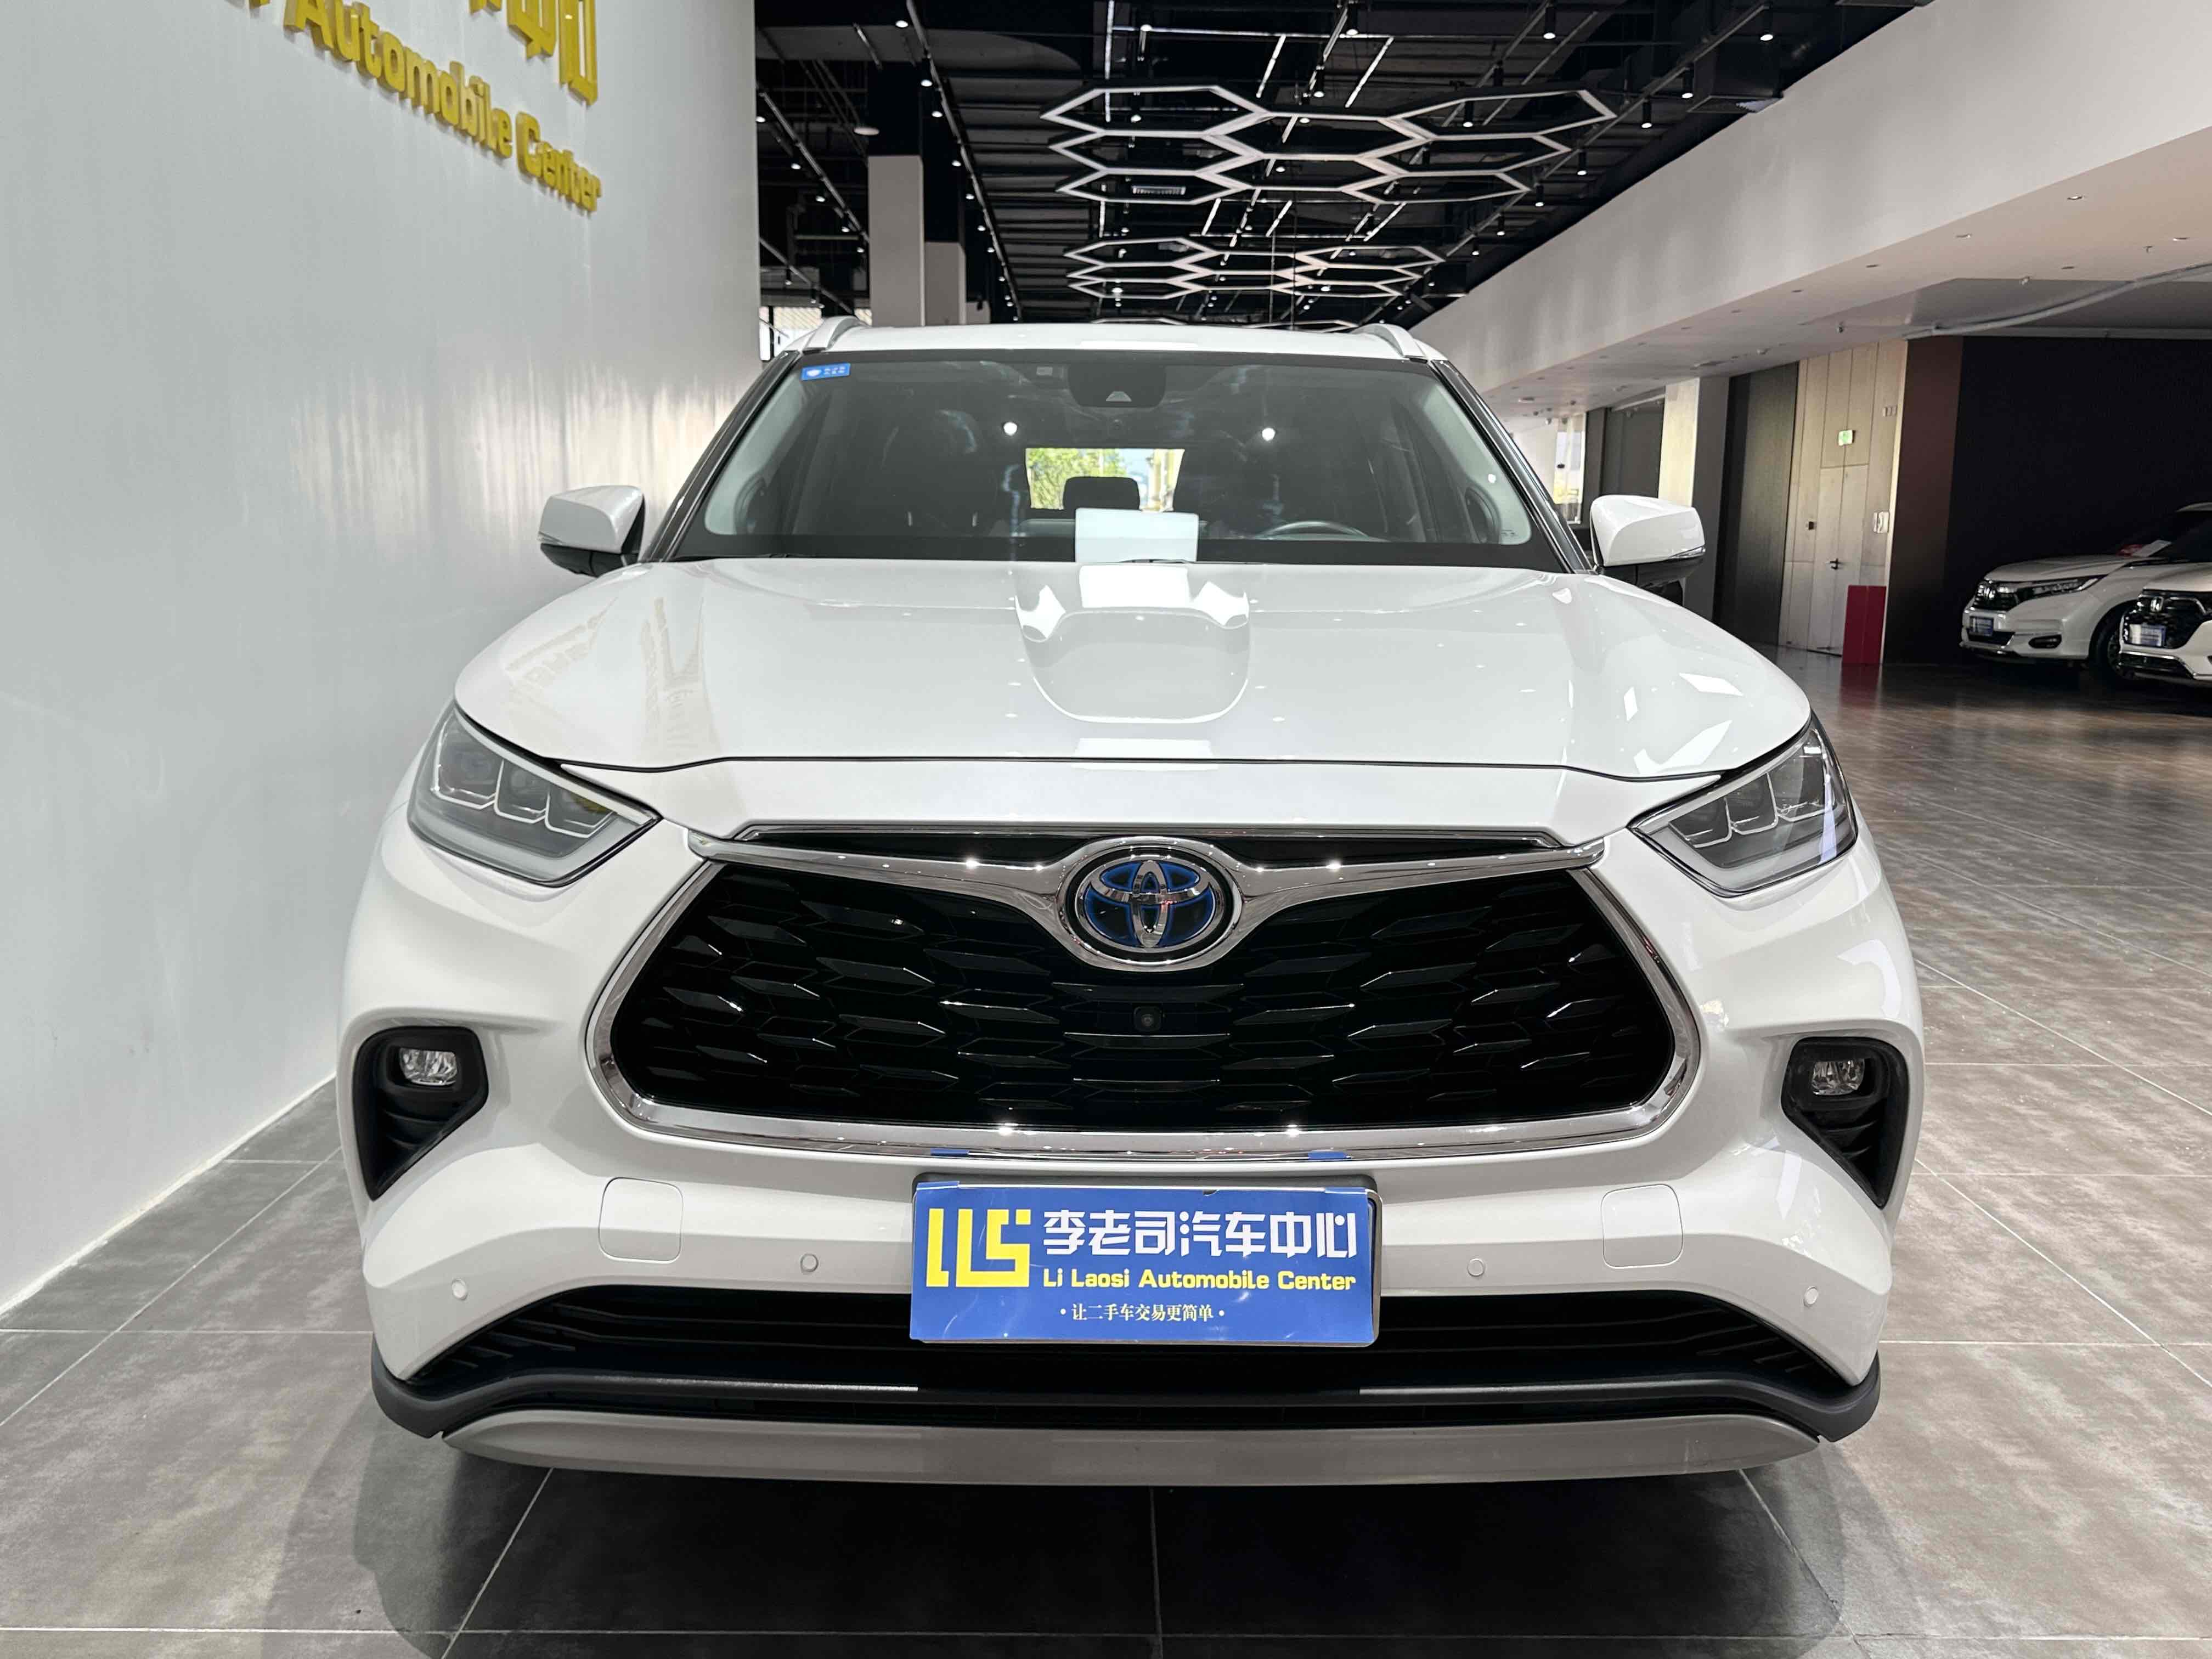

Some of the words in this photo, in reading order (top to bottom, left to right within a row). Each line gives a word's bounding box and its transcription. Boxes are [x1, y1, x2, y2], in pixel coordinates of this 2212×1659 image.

[284, 0, 512, 159] Automobile
[515, 112, 601, 212] Center
[1043, 1209, 1357, 1259] 李老司汽车中心
[1043, 1268, 1063, 1287] Li
[1071, 1268, 1130, 1288] Laosi
[1138, 1269, 1269, 1289] Automobile
[1278, 1271, 1356, 1290] Center
